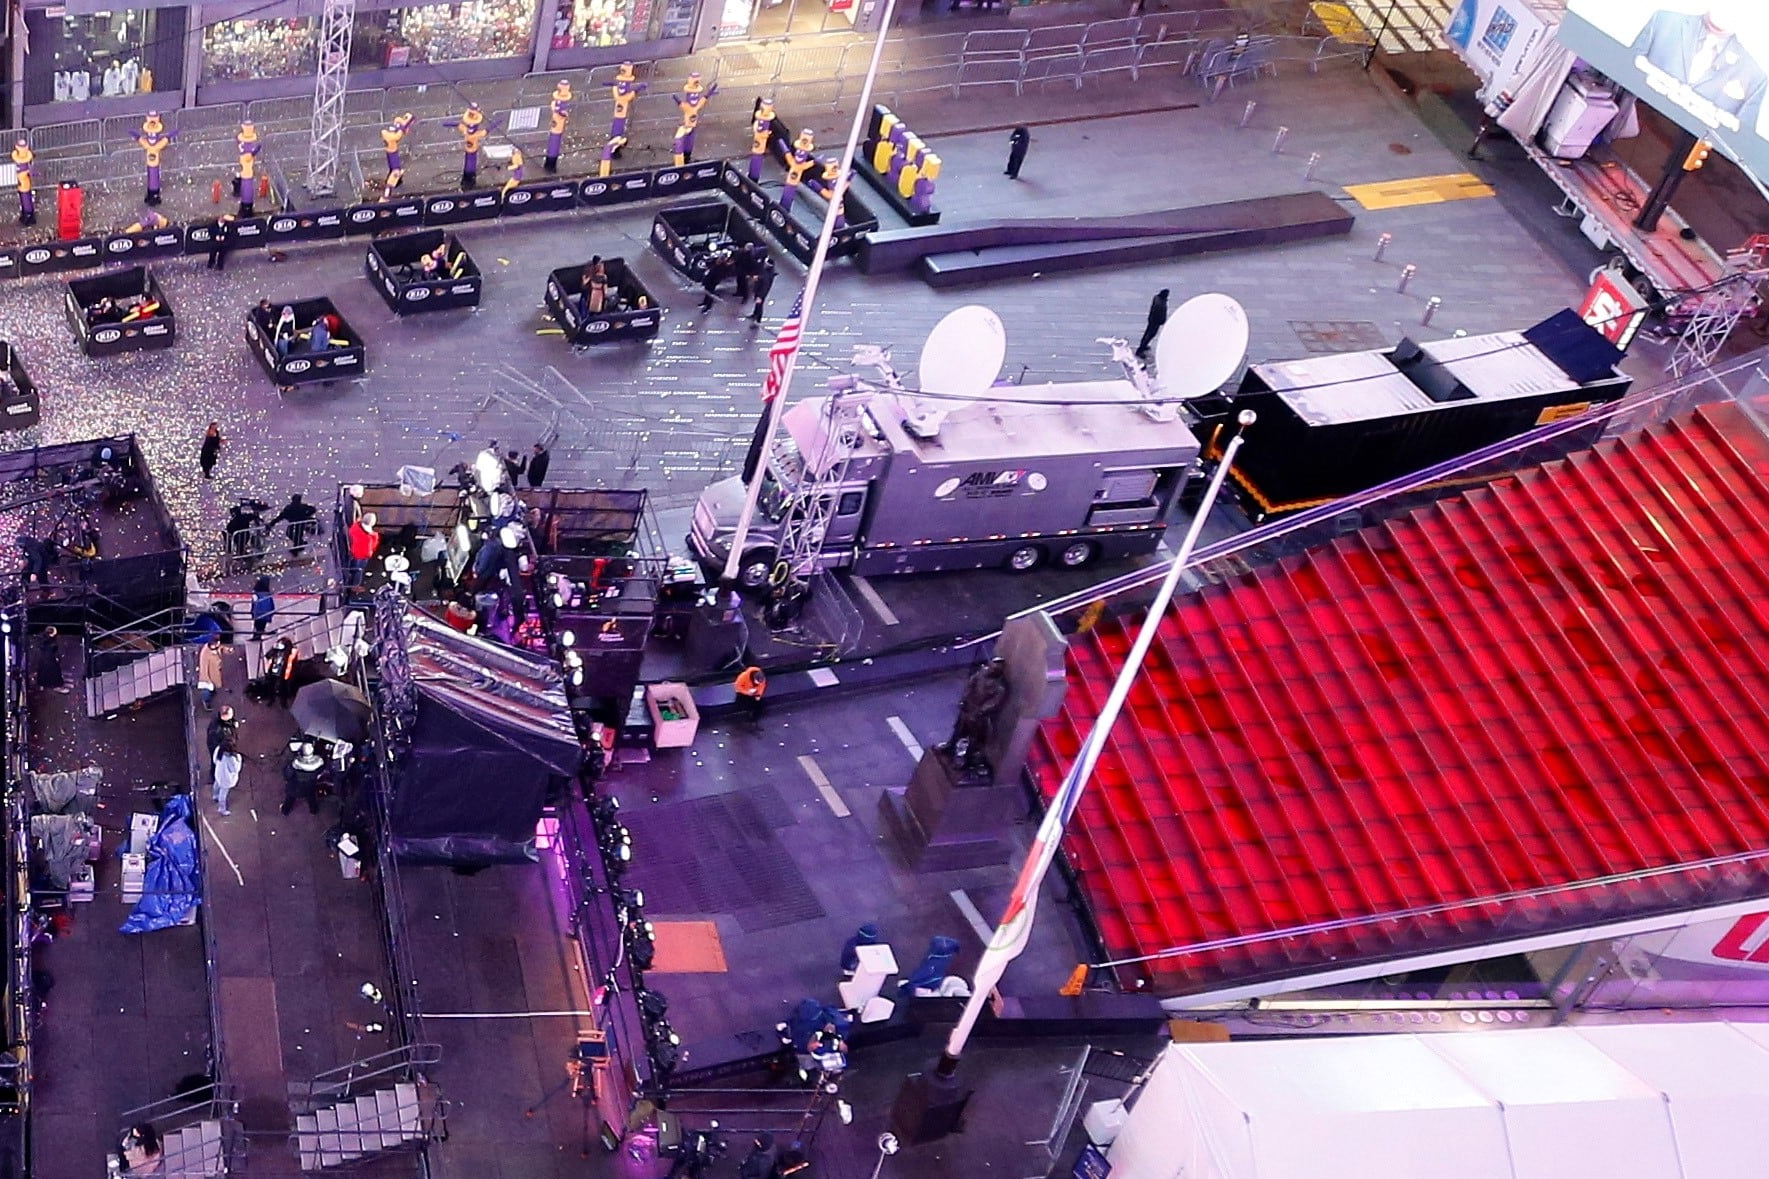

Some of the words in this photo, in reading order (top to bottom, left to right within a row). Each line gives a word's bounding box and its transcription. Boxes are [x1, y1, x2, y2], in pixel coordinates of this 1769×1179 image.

[659, 174, 678, 184] KIA
[586, 184, 605, 194] KIA
[510, 192, 530, 203] KIA
[433, 201, 453, 212] KIA
[354, 210, 374, 221] KIA
[275, 220, 295, 231] KIA
[110, 240, 131, 251] KIA
[27, 251, 49, 262] KIA
[408, 289, 428, 299] KIA
[587, 322, 608, 332] KIA
[97, 331, 119, 341] KIA
[287, 361, 309, 372] KIA
